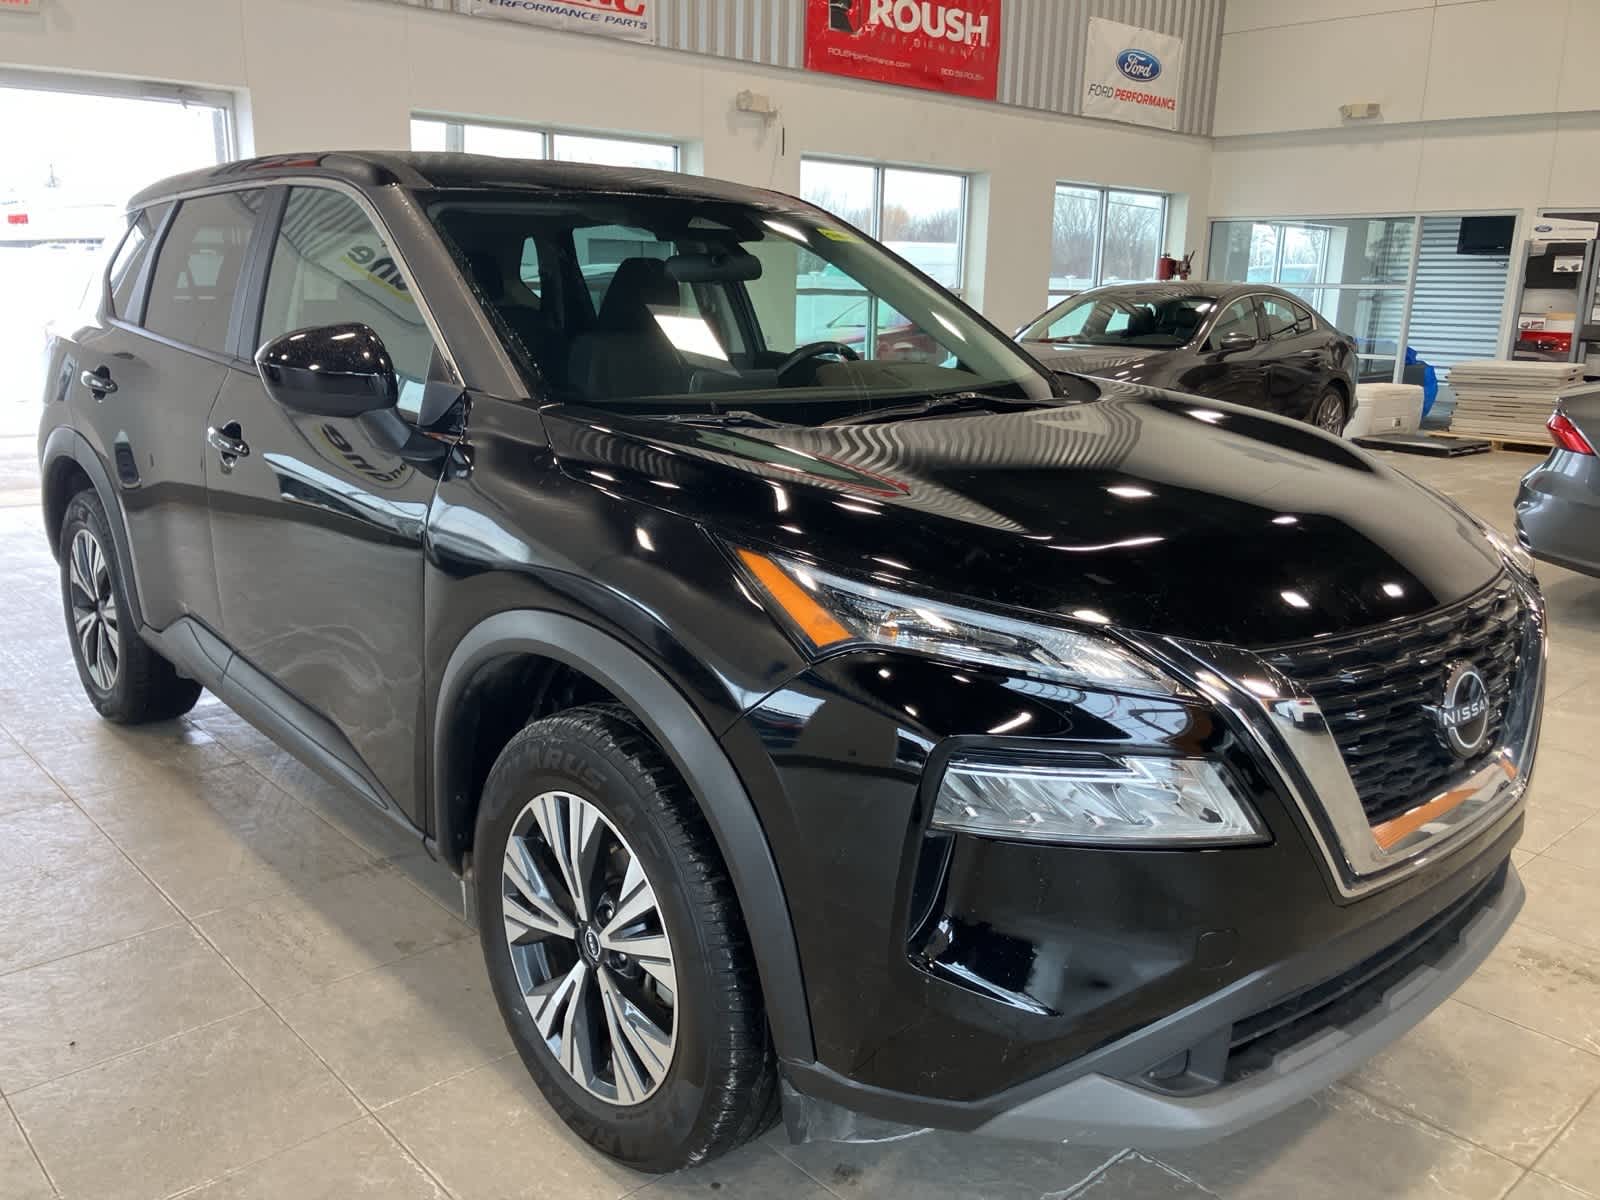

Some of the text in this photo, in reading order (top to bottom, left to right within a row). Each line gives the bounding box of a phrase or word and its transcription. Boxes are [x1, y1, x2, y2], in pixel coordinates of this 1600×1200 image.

[480, 0, 600, 21] RFORMANCE
[604, 15, 648, 30] PARTS
[868, 0, 989, 47] ROUSH
[1124, 53, 1153, 77] Ford
[1088, 83, 1176, 111] FORD PERFORMANCE
